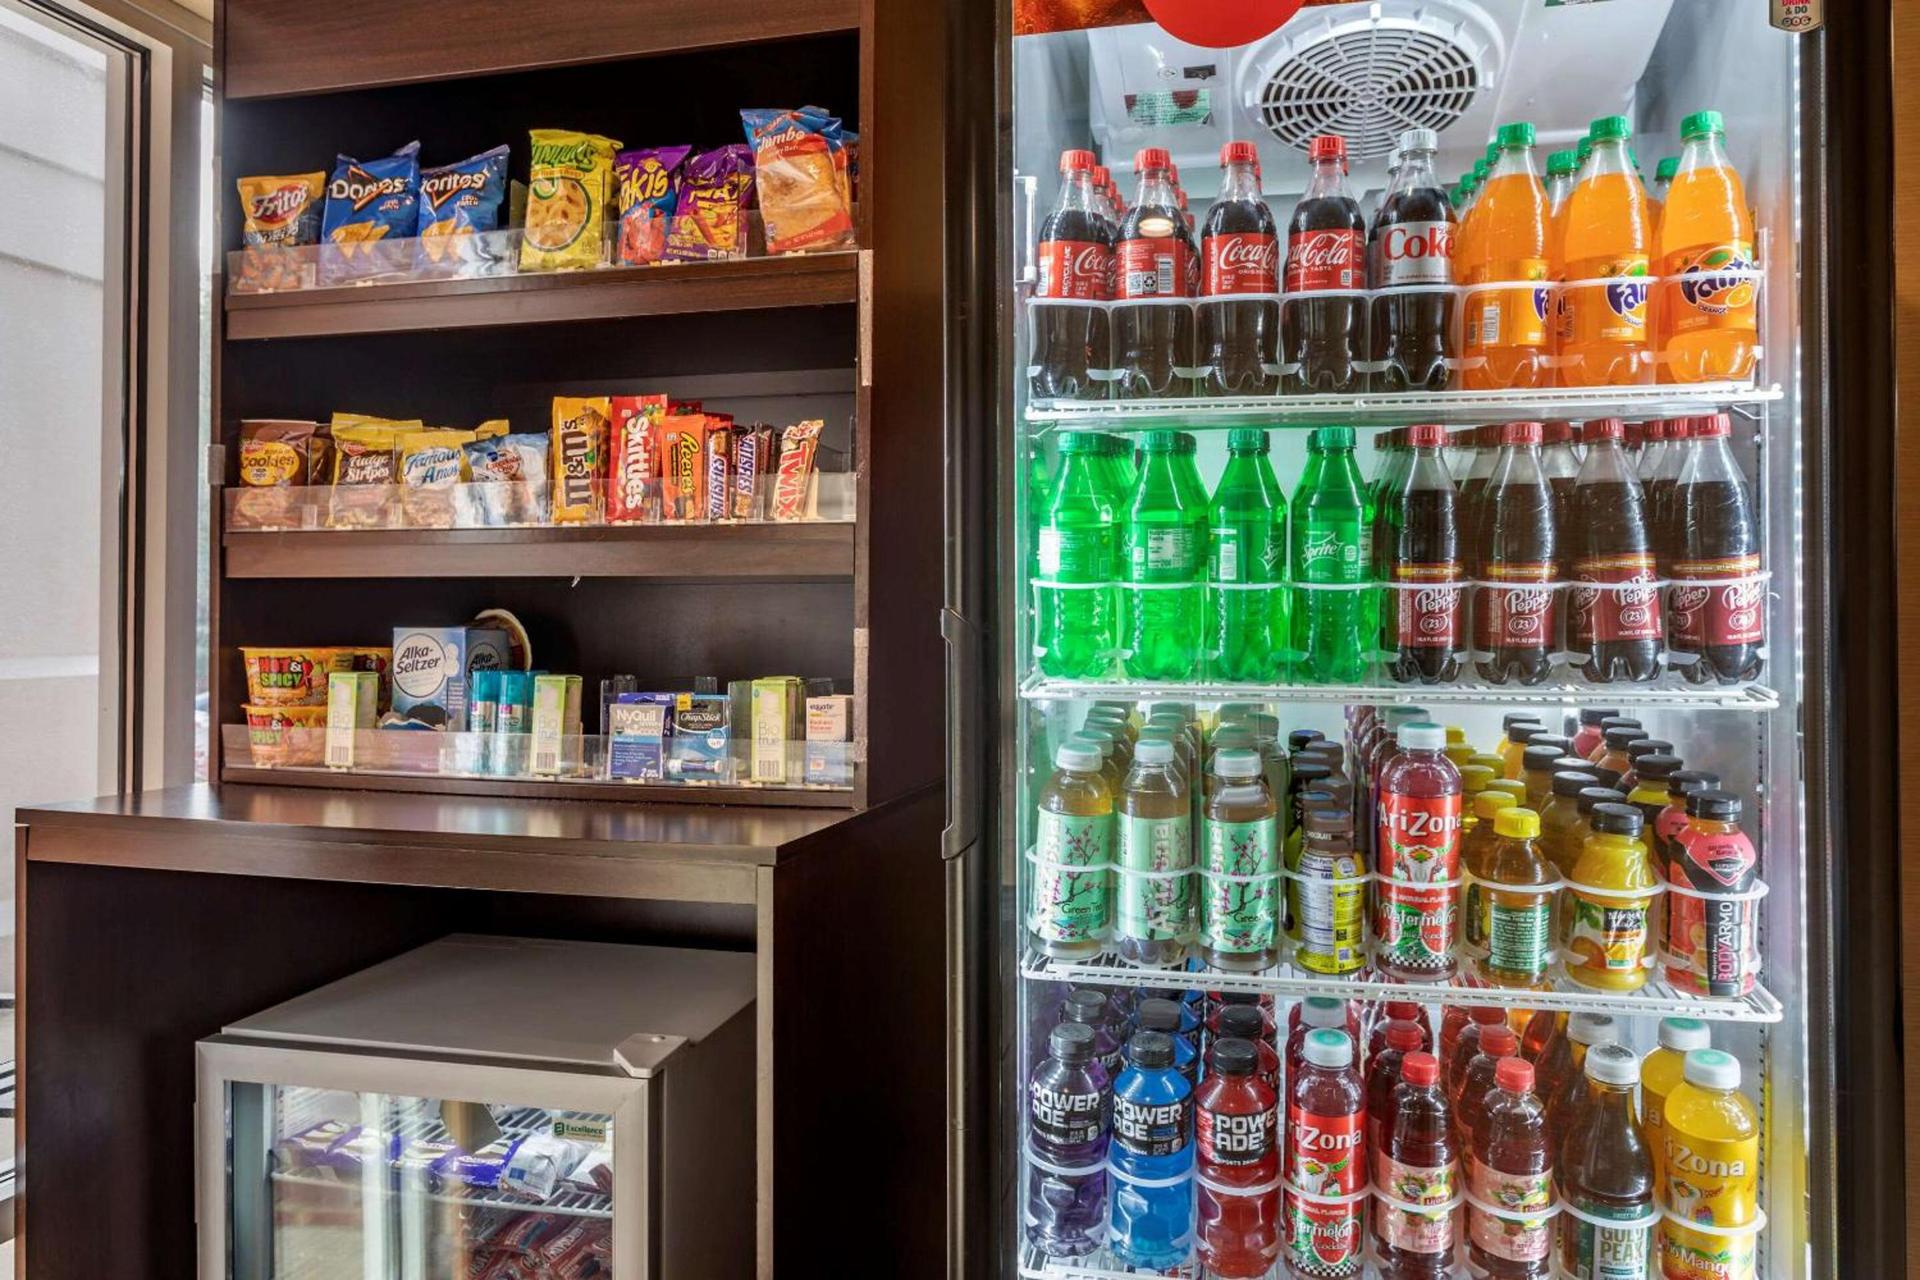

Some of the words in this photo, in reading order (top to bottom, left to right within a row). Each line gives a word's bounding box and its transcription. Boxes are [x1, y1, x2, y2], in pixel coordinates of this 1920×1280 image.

[1795, 6, 1808, 14] DO
[757, 126, 805, 153] Jumbo
[251, 183, 308, 218] Fritos
[1292, 233, 1353, 267] a-Cola
[1384, 227, 1456, 260] Coke
[1219, 237, 1274, 270] Coca-C
[404, 450, 461, 477] Famous
[625, 416, 650, 509] Skittles
[346, 464, 389, 482] Stripes
[422, 465, 458, 484] Amos
[1303, 543, 1337, 559] Sprite
[1428, 618, 1439, 628] 23
[1518, 620, 1529, 629] 23
[1628, 611, 1640, 623] 23
[259, 656, 291, 671] HOT
[396, 656, 441, 675] Seltzer
[261, 671, 302, 687] SPICY
[617, 709, 656, 723] NyQuil
[680, 711, 720, 723] ChapStick
[1378, 801, 1461, 837] AriZona
[1305, 830, 1333, 840] HOCOLATE
[1061, 903, 1091, 914] Green
[1717, 901, 1733, 981] BODYARMO
[1032, 1082, 1100, 1112] POWER
[1033, 1100, 1069, 1128] ADE
[1113, 1093, 1182, 1125] POWER
[566, 1124, 603, 1134] Excellence
[1113, 1113, 1148, 1141] ADE
[1215, 1134, 1261, 1152] ADE
[1600, 1241, 1643, 1261] PEAK
